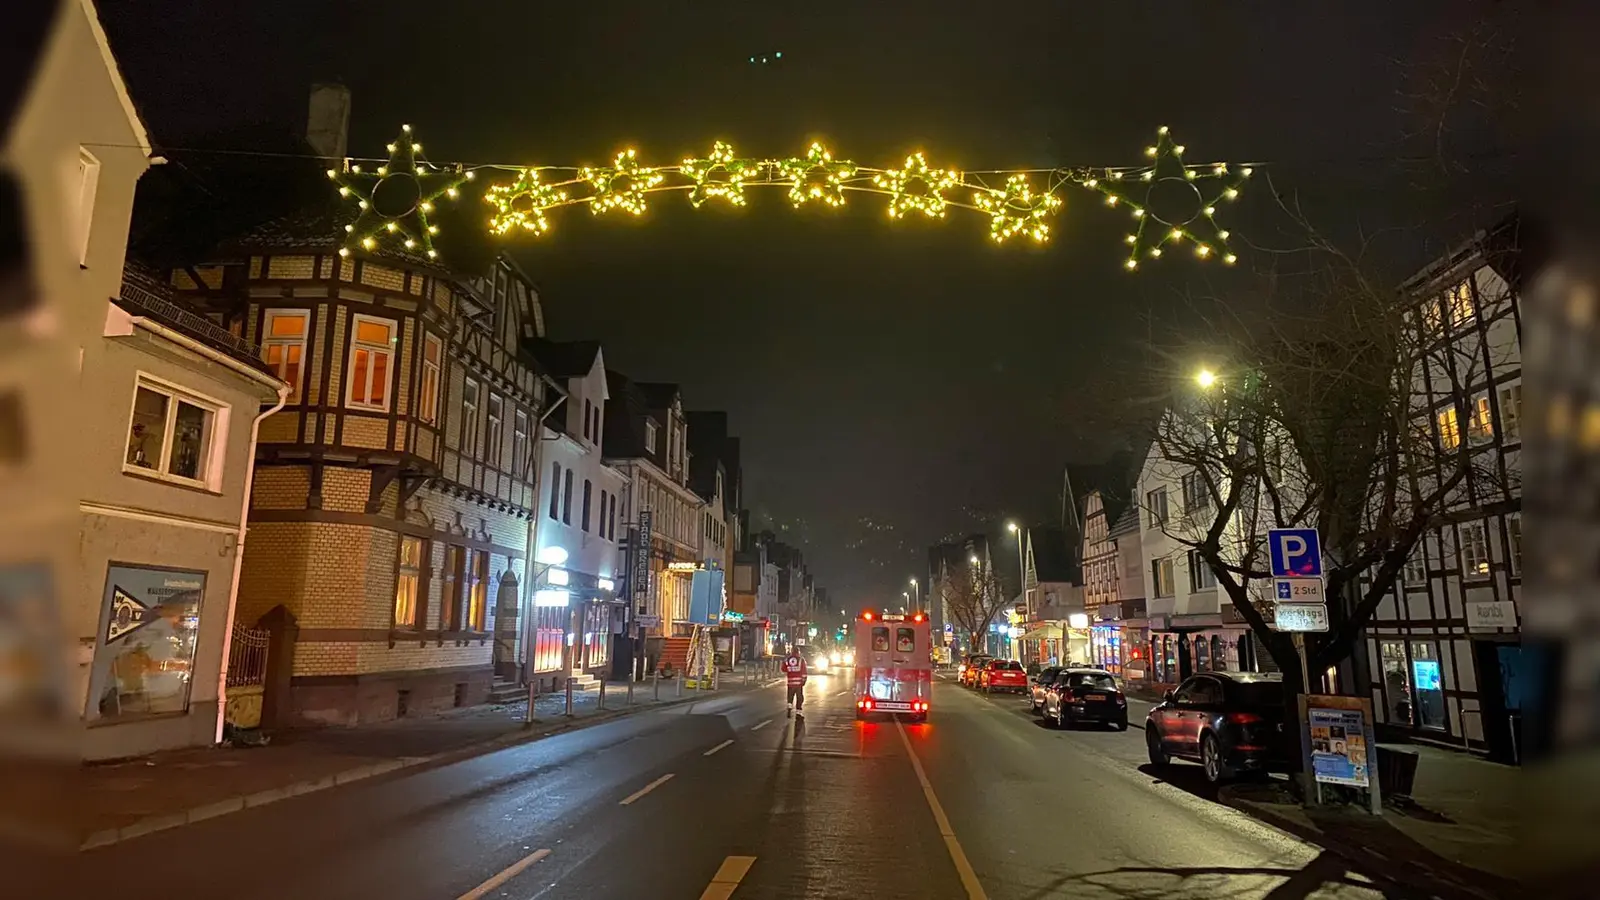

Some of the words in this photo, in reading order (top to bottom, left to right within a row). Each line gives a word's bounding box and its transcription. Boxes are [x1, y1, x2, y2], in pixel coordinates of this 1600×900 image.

[1280, 535, 1307, 570] P
[1294, 587, 1299, 595] 2
[115, 595, 125, 603] W
[111, 627, 118, 635] S
